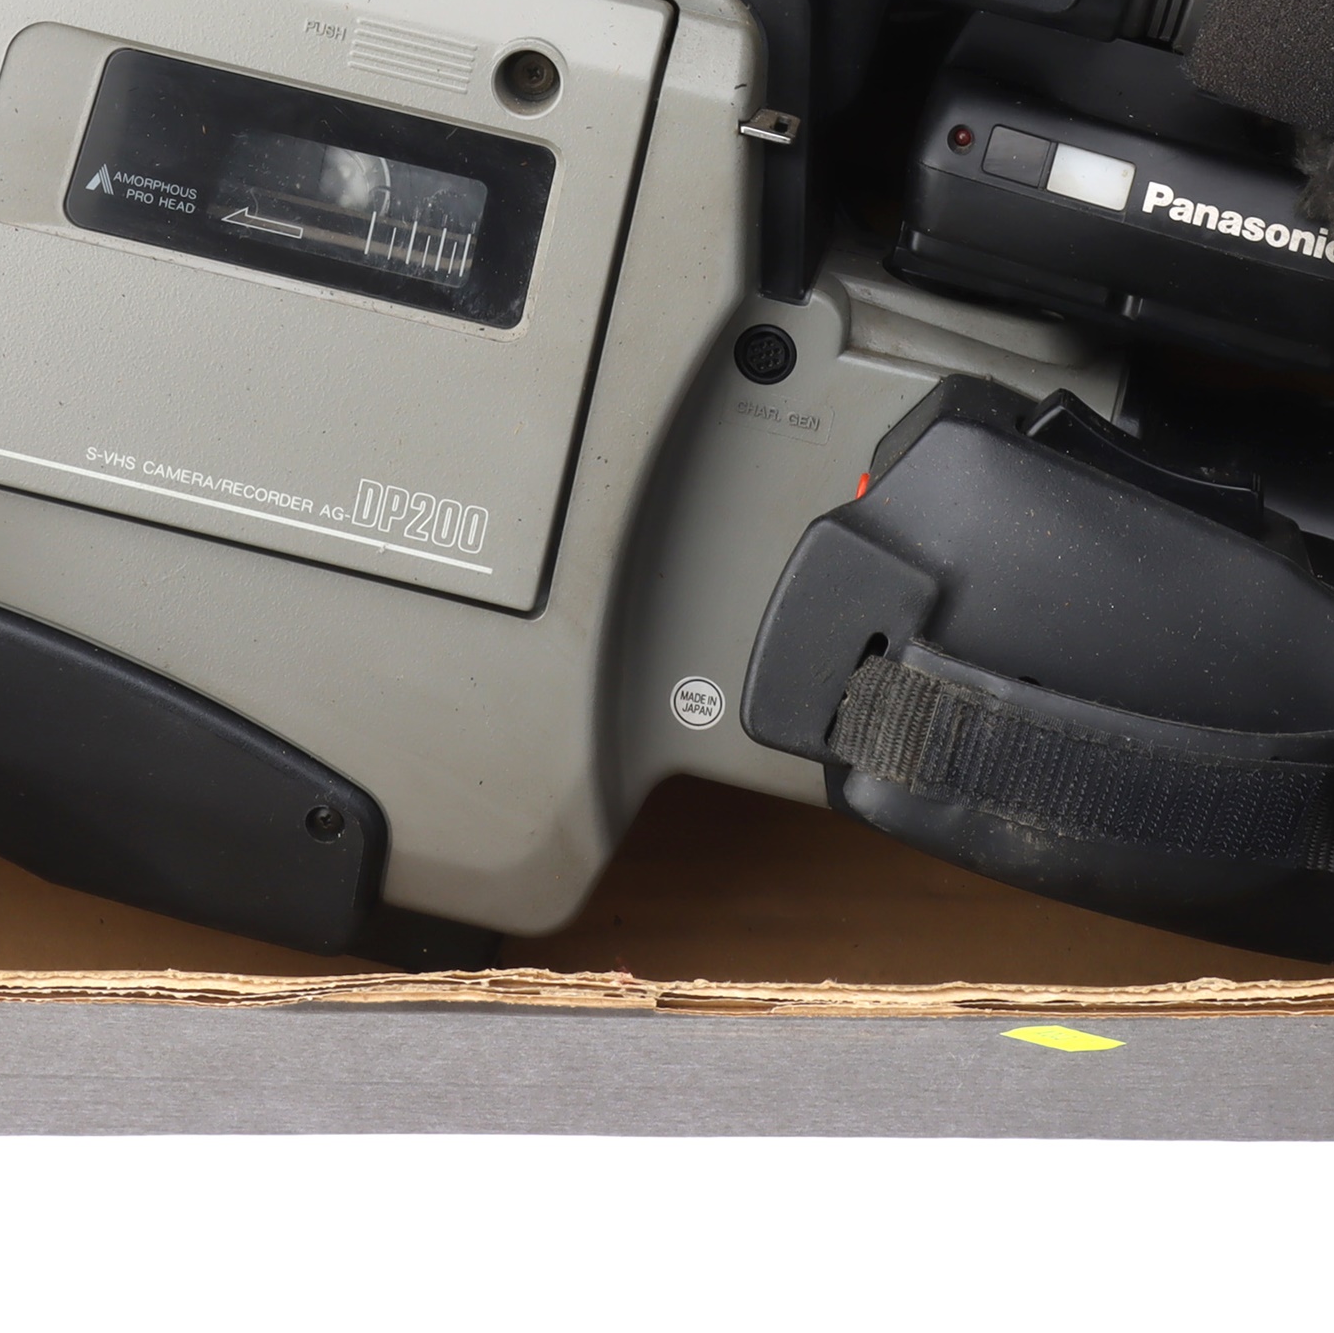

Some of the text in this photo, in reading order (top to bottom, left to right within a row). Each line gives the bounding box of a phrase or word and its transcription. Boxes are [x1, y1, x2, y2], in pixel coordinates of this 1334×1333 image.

[304, 18, 347, 42] PUSH
[113, 170, 198, 201] AMORPHOUS
[126, 187, 196, 214] PRO HEAD
[788, 412, 820, 431] GEN
[85, 447, 136, 471] S-VHS
[142, 462, 314, 514] CAMERA/RECORDER
[680, 690, 717, 706] MADE IN
[682, 703, 713, 717] JAPAN
